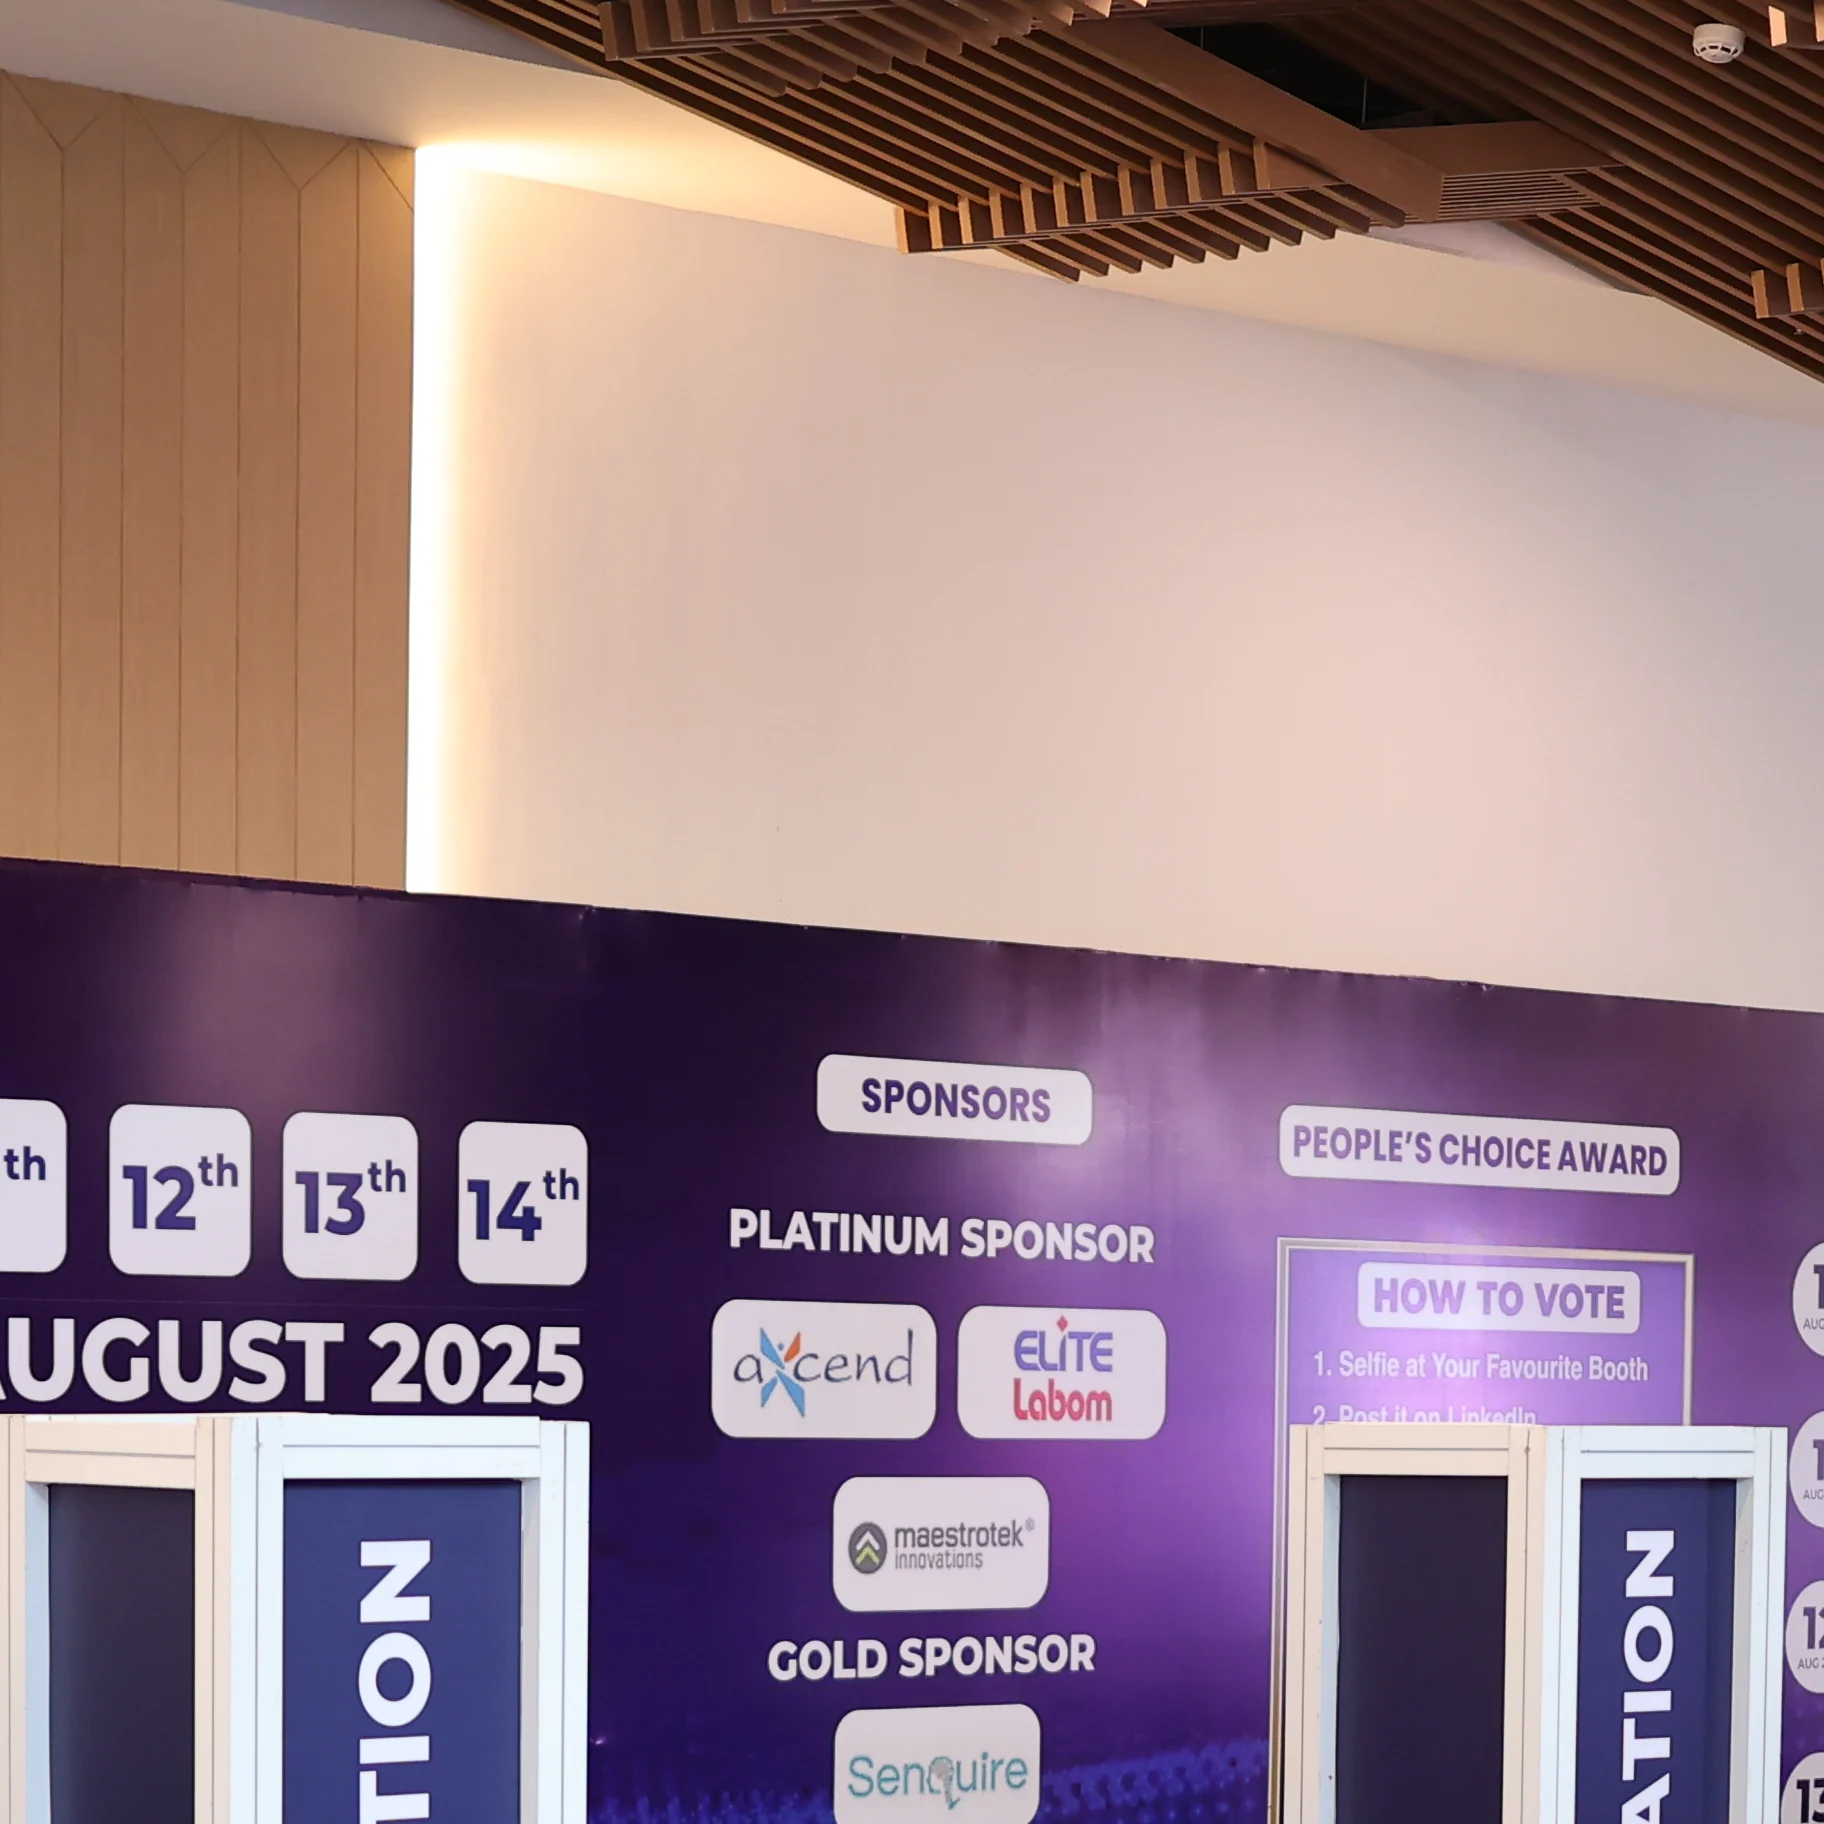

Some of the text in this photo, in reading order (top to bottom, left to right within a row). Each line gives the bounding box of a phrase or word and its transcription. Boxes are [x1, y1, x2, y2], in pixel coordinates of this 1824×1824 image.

[861, 1077, 1051, 1123] SPONSORS
[1439, 1133, 1552, 1171] CHOICE
[1557, 1140, 1668, 1177] AWARD
[122, 1153, 238, 1231] 12th
[295, 1161, 407, 1236] 13th
[467, 1169, 580, 1242] 14th
[729, 1207, 1155, 1263] PLATINUM SPONSOR
[1374, 1276, 1625, 1319] HOW TO VOTE
[368, 1322, 585, 1405] 2025
[1313, 1350, 1649, 1382] 1. Selfie at Your Favourite Booth
[1013, 1377, 1113, 1422] Labom
[894, 1548, 984, 1570] innovations
[767, 1633, 1097, 1681] GOLD SPONSOR
[1797, 1656, 1820, 1670] AUG
